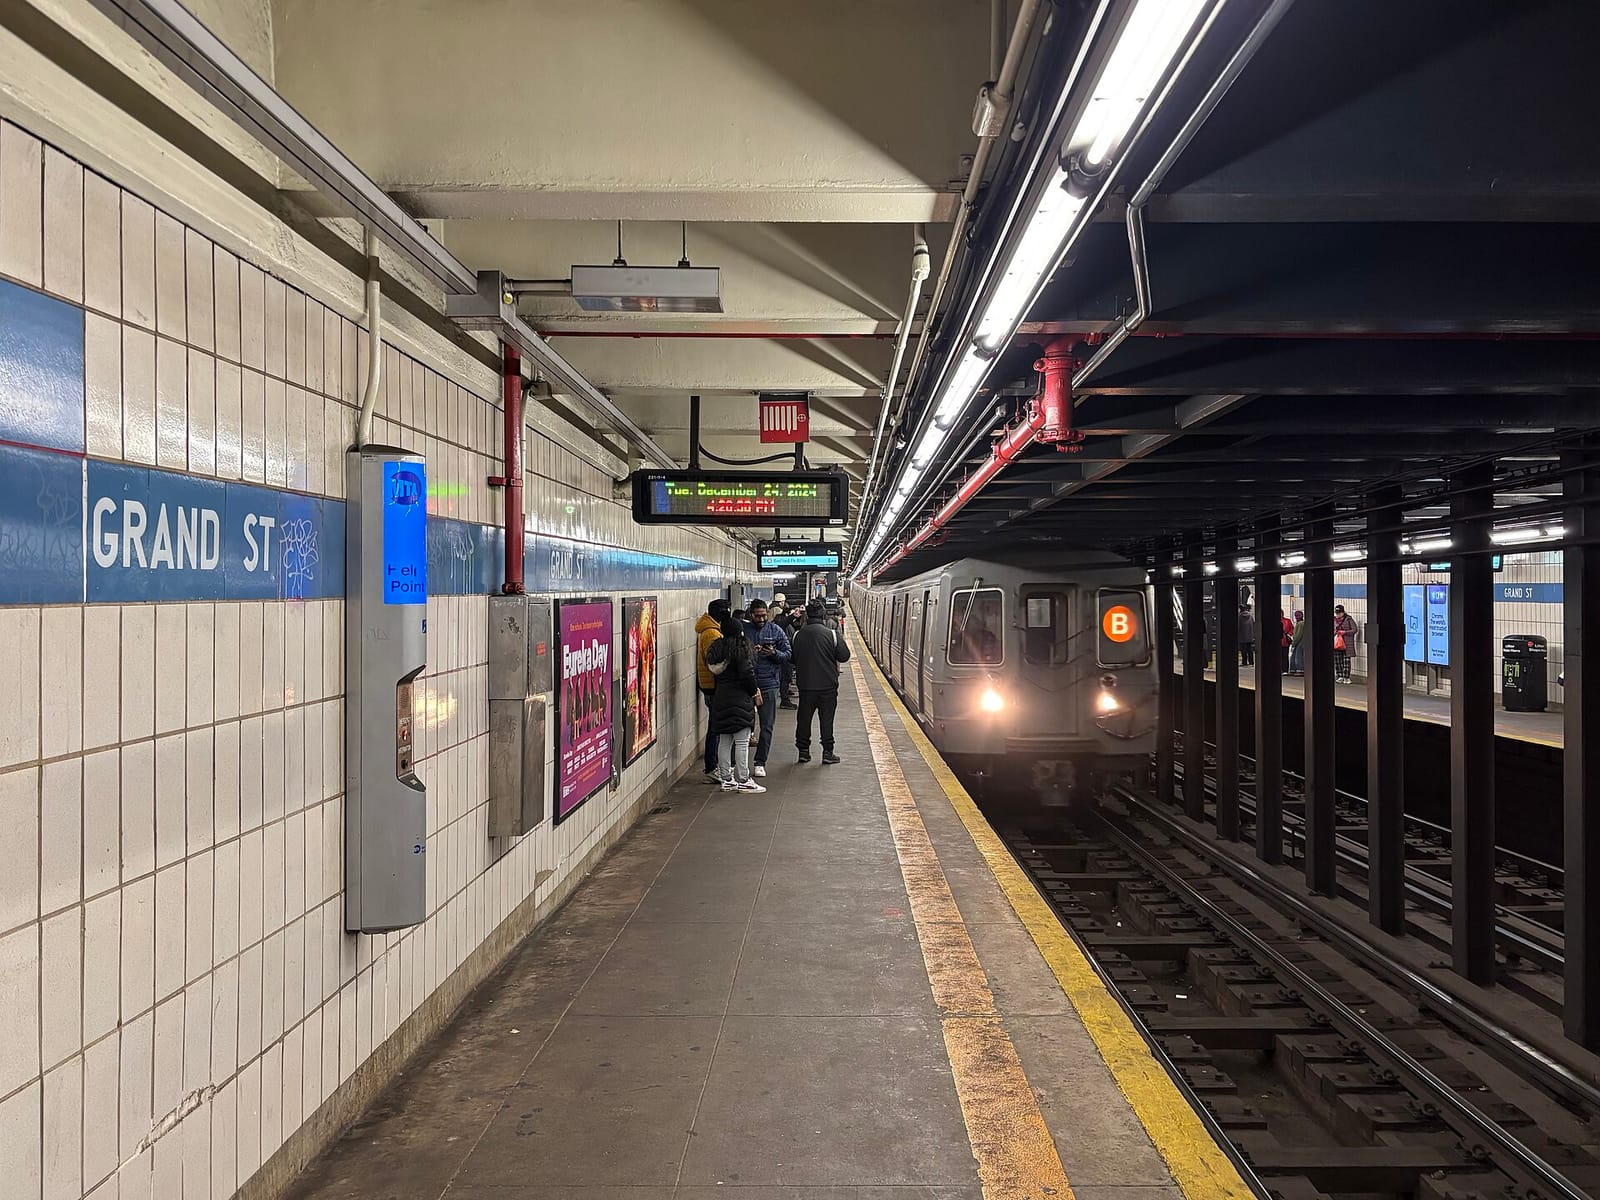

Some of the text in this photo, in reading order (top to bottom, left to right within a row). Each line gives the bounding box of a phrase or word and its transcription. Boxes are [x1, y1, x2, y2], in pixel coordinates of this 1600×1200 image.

[92, 497, 220, 569] GRAND
[243, 513, 276, 572] ST
[550, 550, 585, 580] GRAND ST
[391, 580, 425, 592] Point
[1504, 587, 1533, 598] GRAND ST
[1111, 613, 1129, 635] B
[563, 639, 592, 680] Eureka
[592, 638, 609, 674] Day
